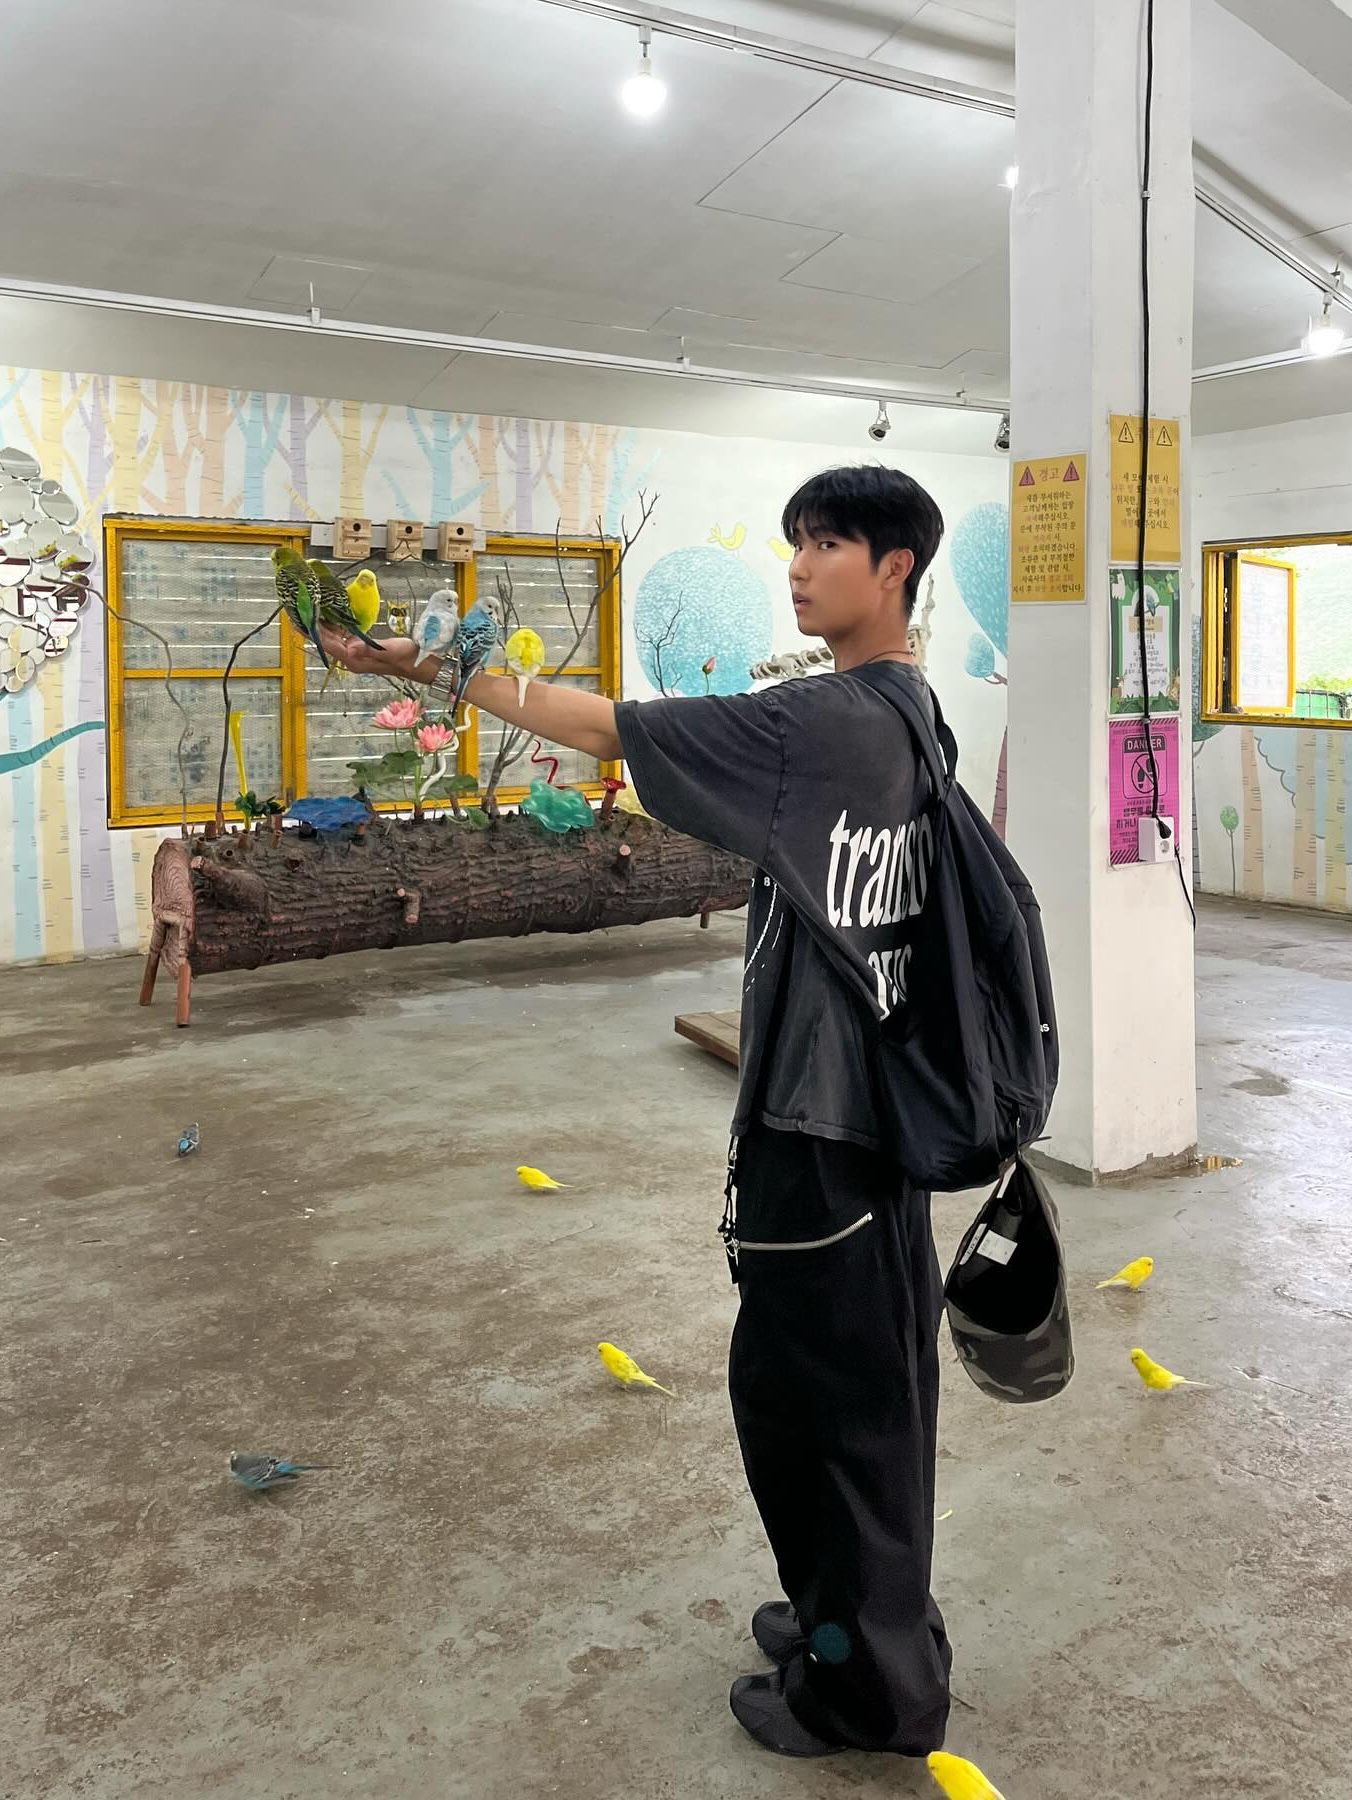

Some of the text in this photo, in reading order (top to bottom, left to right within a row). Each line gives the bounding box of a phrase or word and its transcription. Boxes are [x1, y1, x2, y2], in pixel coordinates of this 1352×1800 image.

[1040, 465, 1060, 482] 경고
[1041, 491, 1072, 501] 무서워하는
[1020, 500, 1075, 513] 고객님께서는 입장
[1127, 738, 1162, 750] DANER
